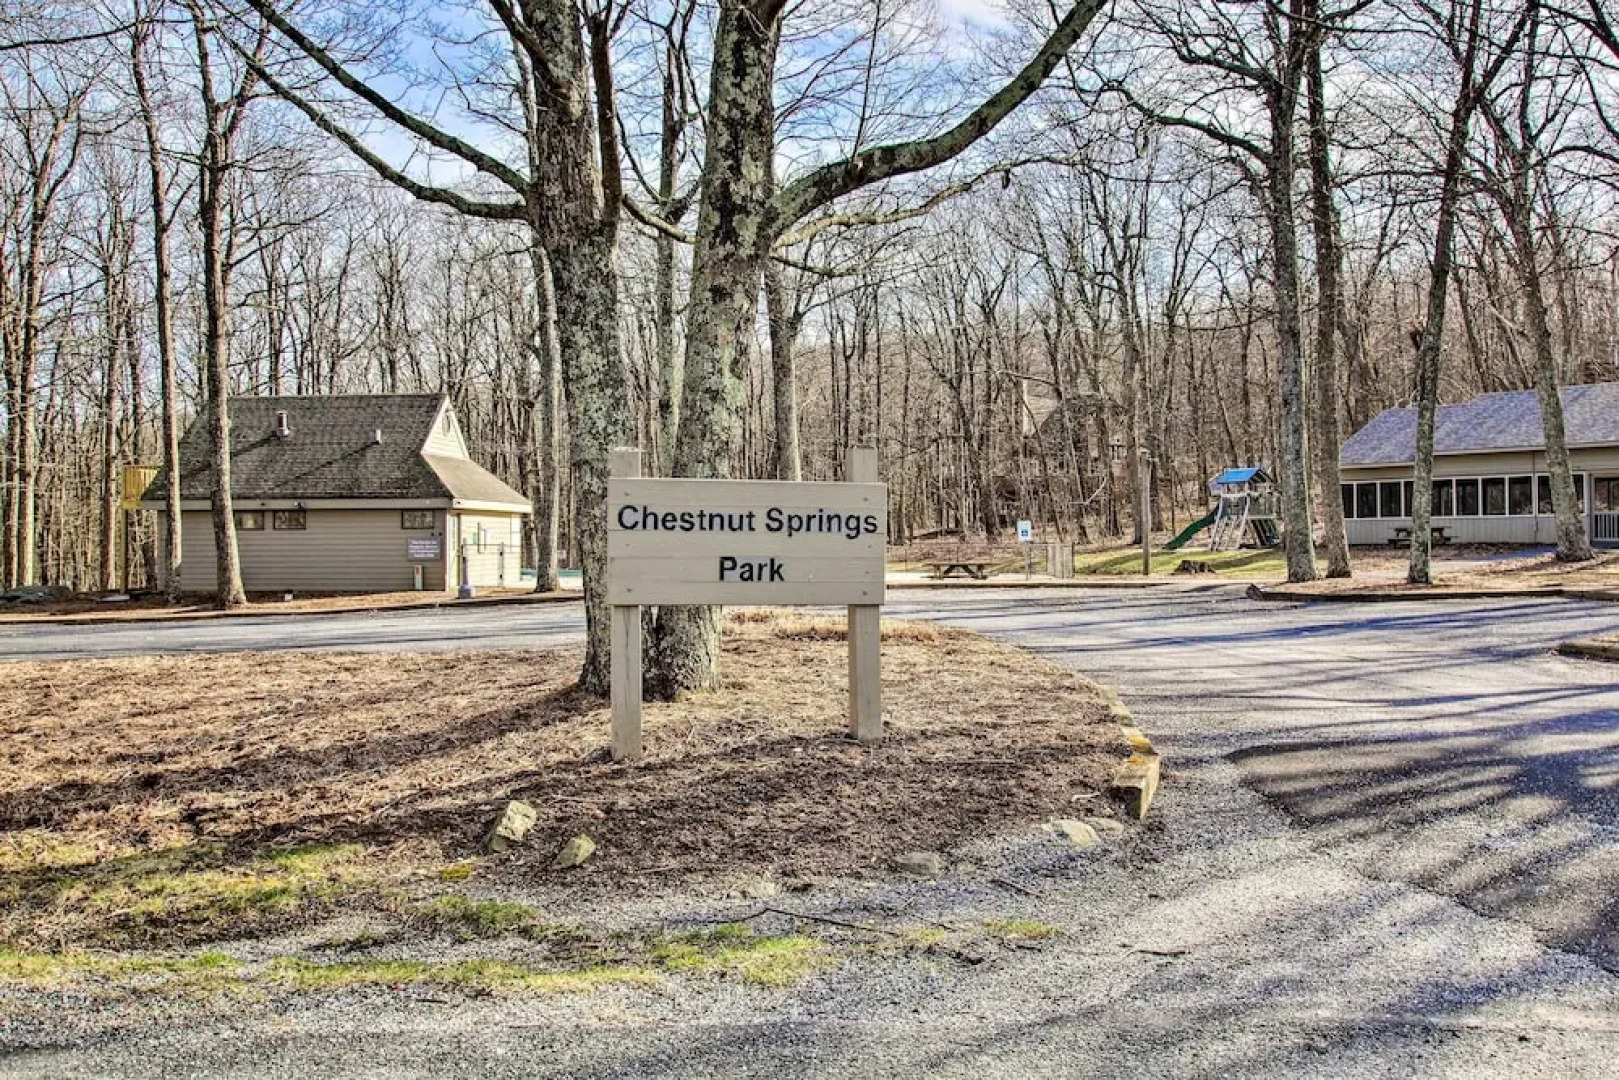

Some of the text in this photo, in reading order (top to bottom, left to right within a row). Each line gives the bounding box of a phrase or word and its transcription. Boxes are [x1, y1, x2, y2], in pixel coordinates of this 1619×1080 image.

[617, 504, 878, 540] Chestnut Springs
[718, 556, 785, 582] Park
